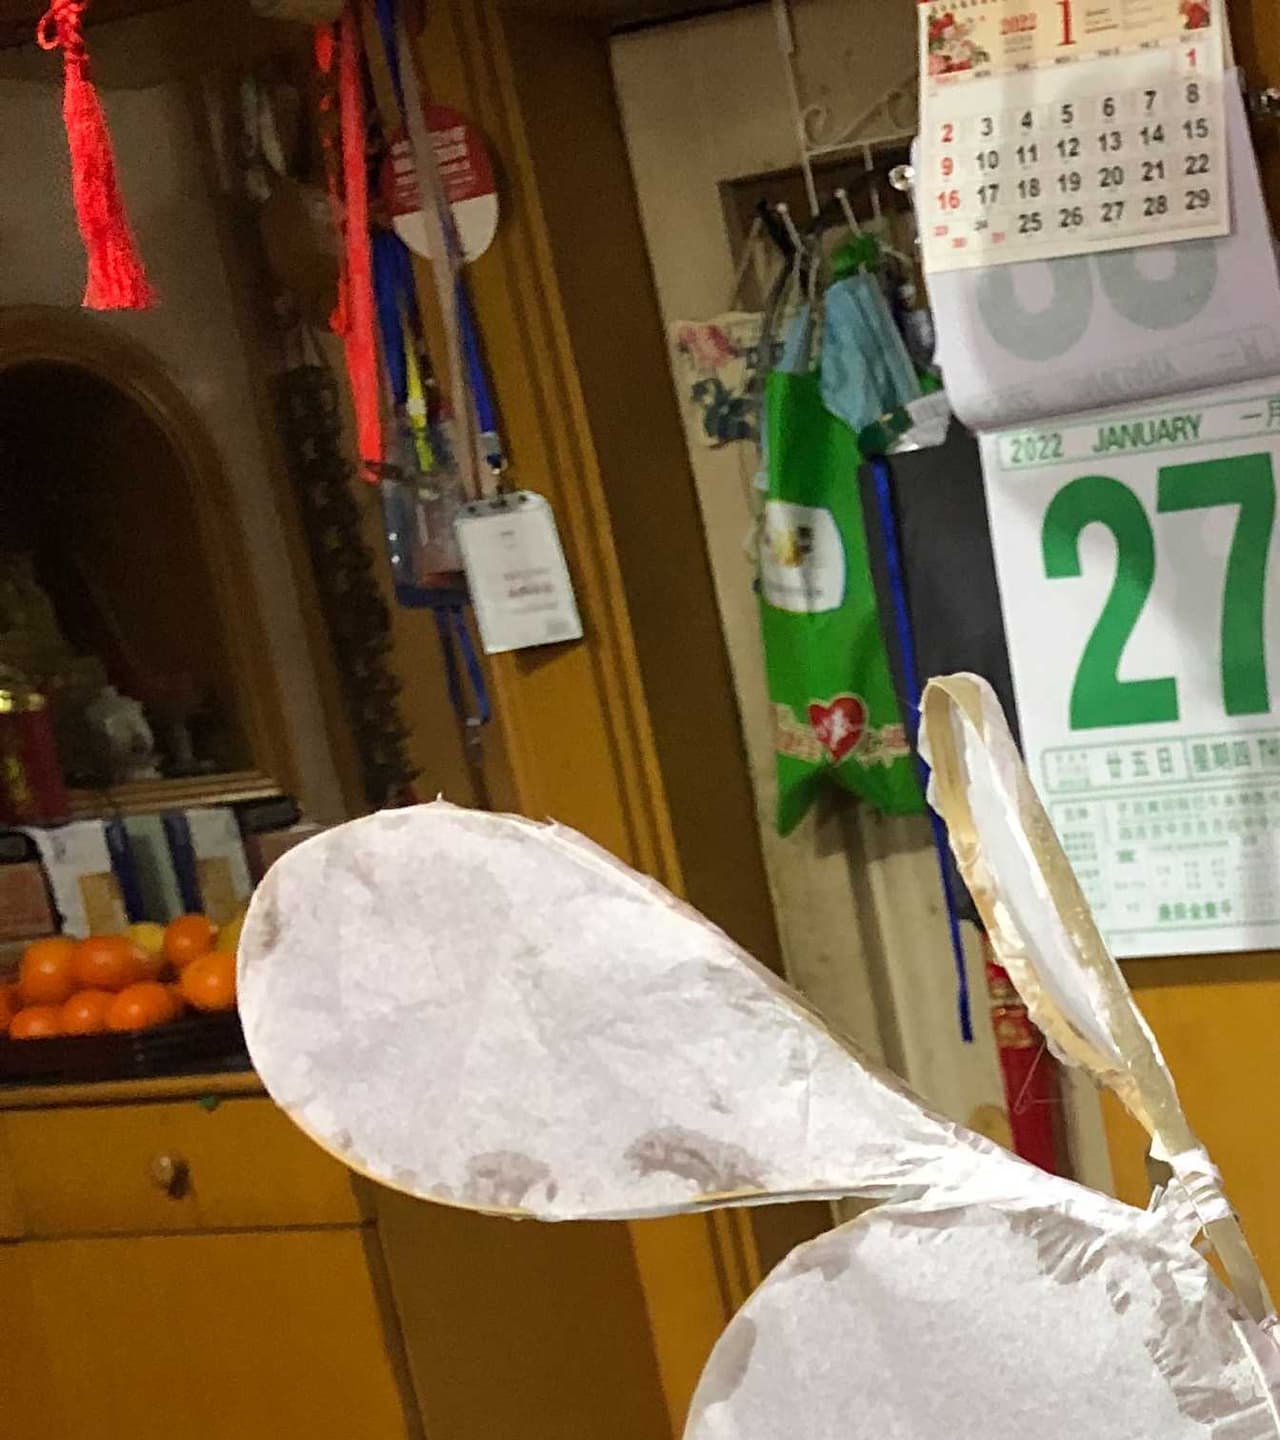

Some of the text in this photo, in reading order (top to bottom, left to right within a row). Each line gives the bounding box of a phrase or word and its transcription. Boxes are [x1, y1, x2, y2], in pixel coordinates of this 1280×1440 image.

[1058, 0, 1076, 46] 1
[1187, 48, 1197, 67] 1
[941, 83, 1199, 143] 2 3 4 5 6 7 8
[941, 118, 1209, 176] 9 10 11 12 13 14 15
[937, 154, 1210, 210] 16 17 18 19 20 21 22
[1018, 213, 1043, 233] 25
[1059, 207, 1083, 228] 26
[1101, 201, 1125, 222] 27
[1143, 195, 1168, 216] 28
[1185, 189, 1210, 210] 29
[1009, 413, 1202, 463] 2022 JANUARY
[1041, 452, 1276, 731] 27
